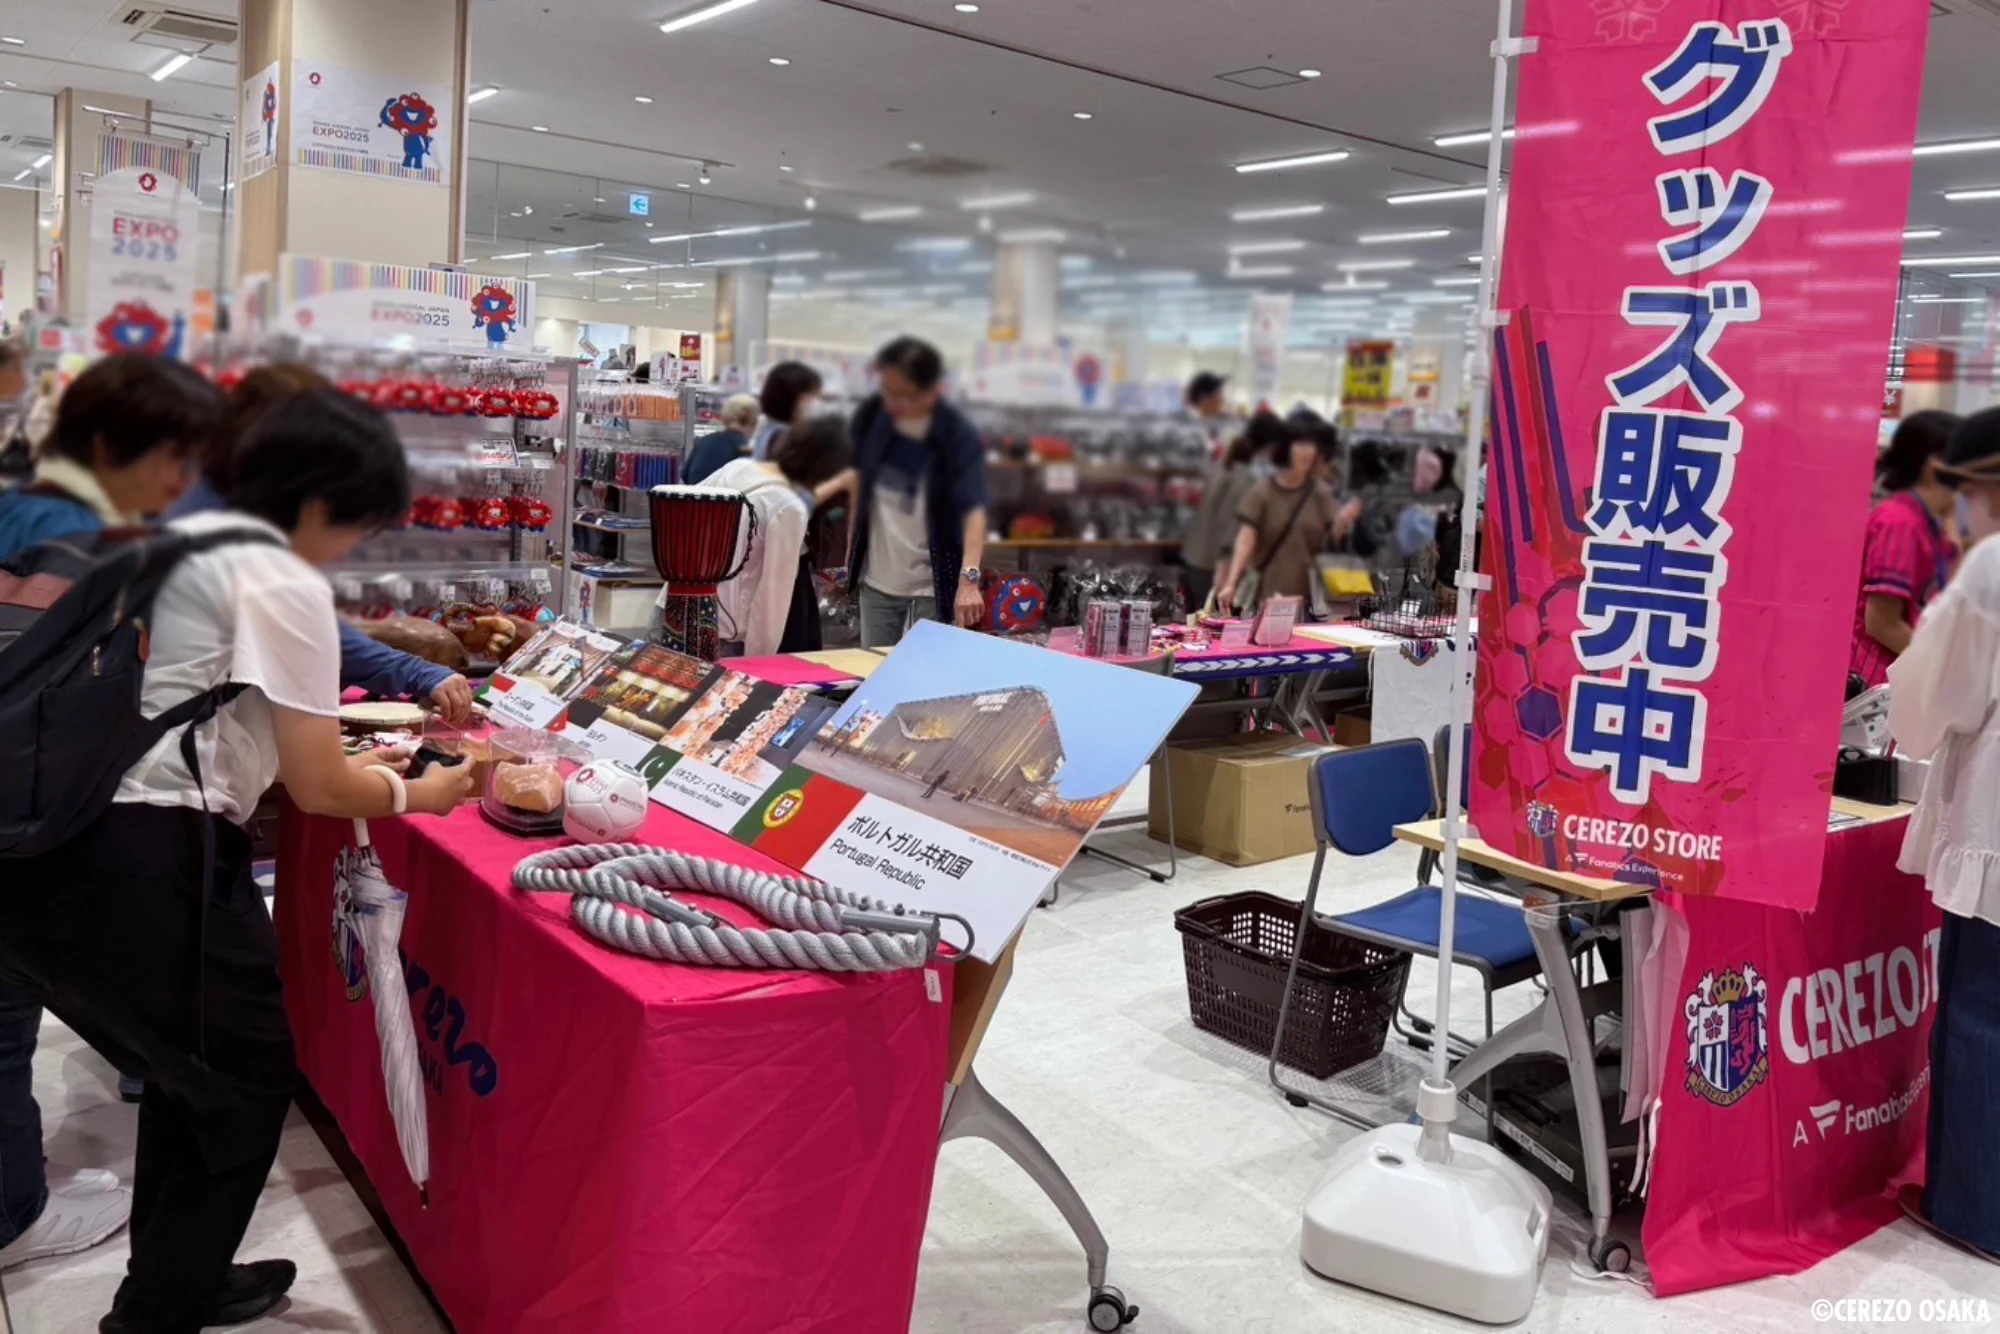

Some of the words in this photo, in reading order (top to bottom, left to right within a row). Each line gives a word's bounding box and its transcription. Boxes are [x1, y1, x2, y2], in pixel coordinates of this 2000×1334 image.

[312, 126, 370, 143] EXPO2025
[113, 217, 179, 246] EXPO
[1565, 17, 1793, 806] グッズ販売中
[847, 815, 973, 880] ポルトガル共和国
[1563, 814, 1649, 850] CEREZO
[1653, 828, 1723, 861] STORE
[829, 837, 879, 868] Portugal
[875, 857, 926, 891] Republic
[1588, 855, 1632, 873] Fanatics
[1631, 863, 1685, 882] Experience
[1779, 945, 1921, 1065] CEREZO
[1792, 1119, 1809, 1149] A
